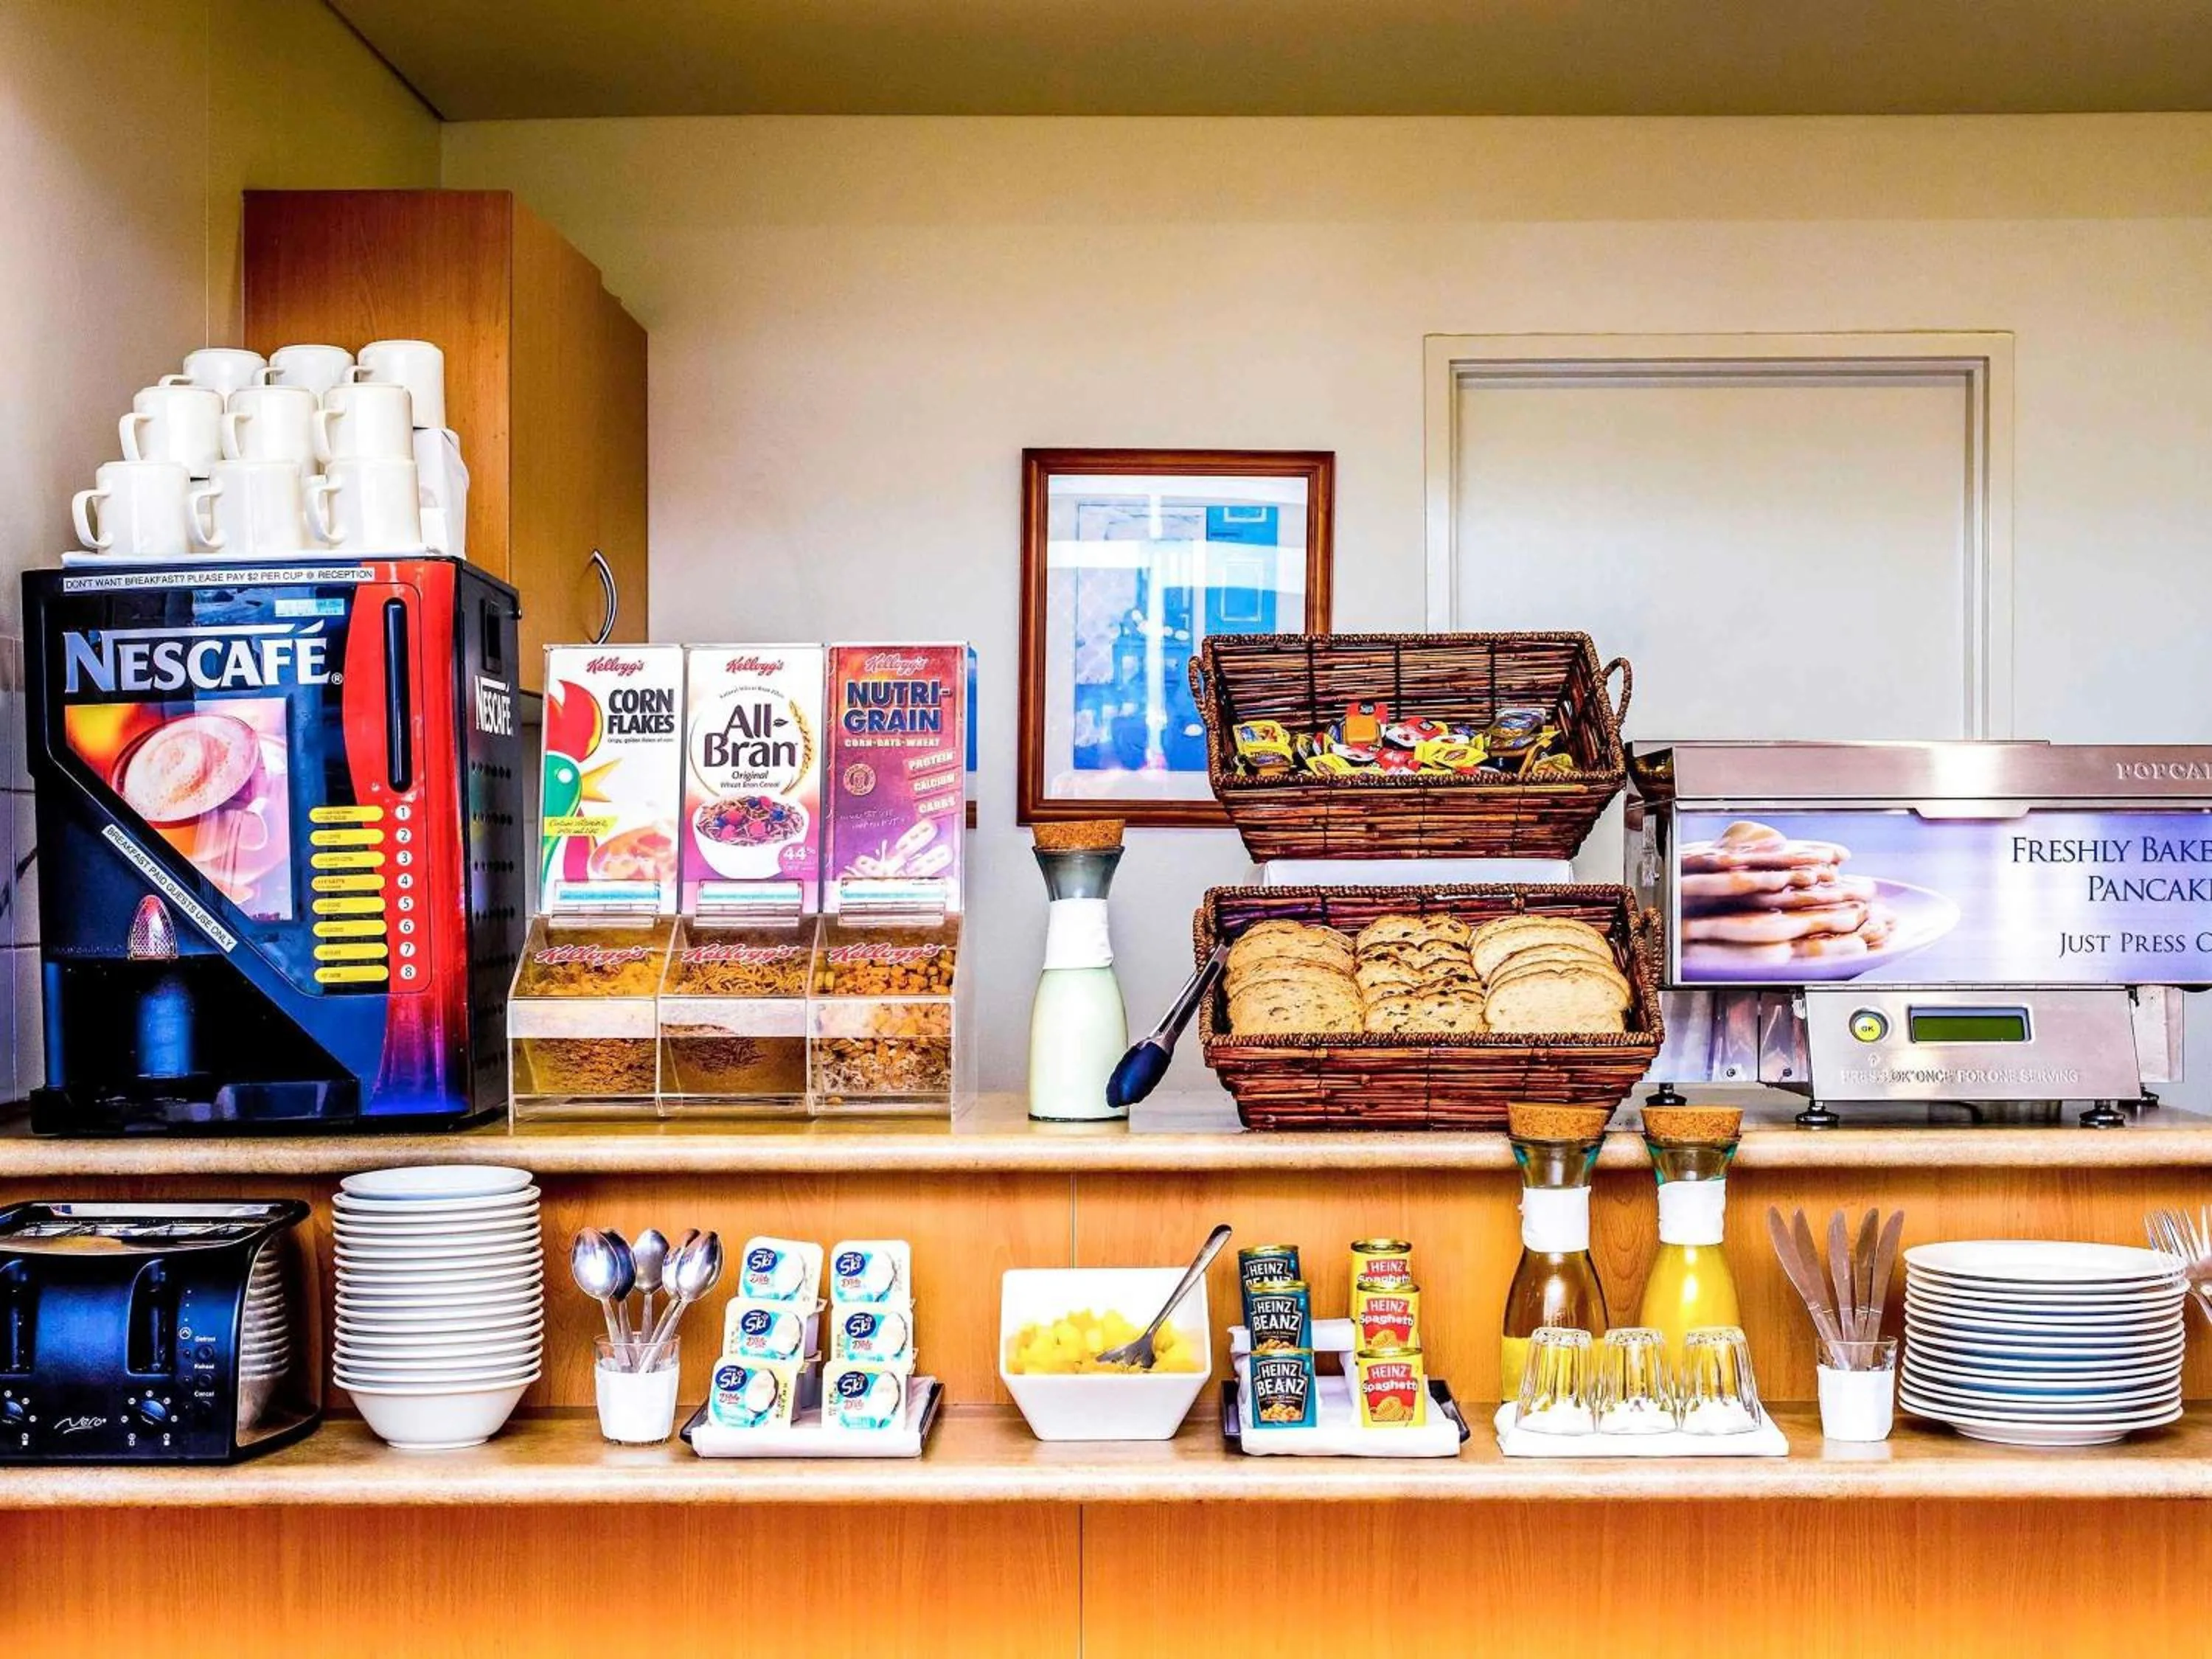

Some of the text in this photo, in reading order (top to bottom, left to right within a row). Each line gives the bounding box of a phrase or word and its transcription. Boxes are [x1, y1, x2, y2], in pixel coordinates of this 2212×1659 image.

[66, 579, 93, 589] DON'T
[96, 577, 122, 587] WANT
[125, 575, 184, 585] BREAKFAST?
[187, 572, 223, 583] PLEASE
[226, 572, 245, 582] PAY
[247, 571, 258, 581] $2
[261, 571, 280, 580] PER
[283, 571, 302, 580] CUP
[319, 569, 372, 580] RECEPTION
[586, 655, 645, 676] Kellogg's
[726, 655, 785, 676] Kellogg's
[865, 653, 928, 675] Kellogg's
[608, 688, 675, 714] CORN
[846, 679, 950, 707] NUTRI-
[608, 714, 675, 734] FLAKES
[844, 708, 942, 734] GRAIN
[703, 732, 796, 768] Bran
[908, 751, 954, 771] PROTEIN
[731, 771, 769, 782] Original
[914, 773, 955, 793] CALCIUM
[919, 796, 956, 814] CARBS
[400, 830, 408, 841] 2
[402, 852, 408, 863] 3
[2011, 836, 2132, 863] FRESHLY
[106, 826, 234, 948] BREAKFAST PAID GUESTS USE ONLY
[400, 875, 408, 886] 4
[2087, 875, 2212, 902] PANCAK
[403, 897, 410, 909] 5
[403, 921, 411, 932] 6
[404, 943, 411, 954] 7
[534, 943, 653, 967] Kellogg's
[681, 943, 801, 965] Kellogg's
[827, 942, 947, 964] Kellogg's
[2059, 932, 2111, 959] JUST
[2121, 932, 2186, 953] PRESS
[405, 967, 413, 977] 8
[1957, 1070, 1986, 1083] FOR
[1988, 1070, 2015, 1083] ONE
[2020, 1069, 2079, 1083] SERVING
[751, 1253, 773, 1270] Ski
[840, 1256, 862, 1275] Ski
[1250, 1262, 1283, 1276] HEINZ
[1371, 1260, 1404, 1272] HEINZ
[1257, 1300, 1292, 1313] HEINZ
[1370, 1300, 1405, 1312] HEINZ
[745, 1314, 768, 1332] Ski
[849, 1316, 872, 1336] Ski
[1253, 1314, 1300, 1331] BEANZ
[719, 1370, 743, 1389] Ski
[1261, 1363, 1298, 1377] HEINZ
[1371, 1366, 1407, 1378] HEINZ
[841, 1375, 865, 1396] Ski
[1256, 1377, 1304, 1396] BEANZ
